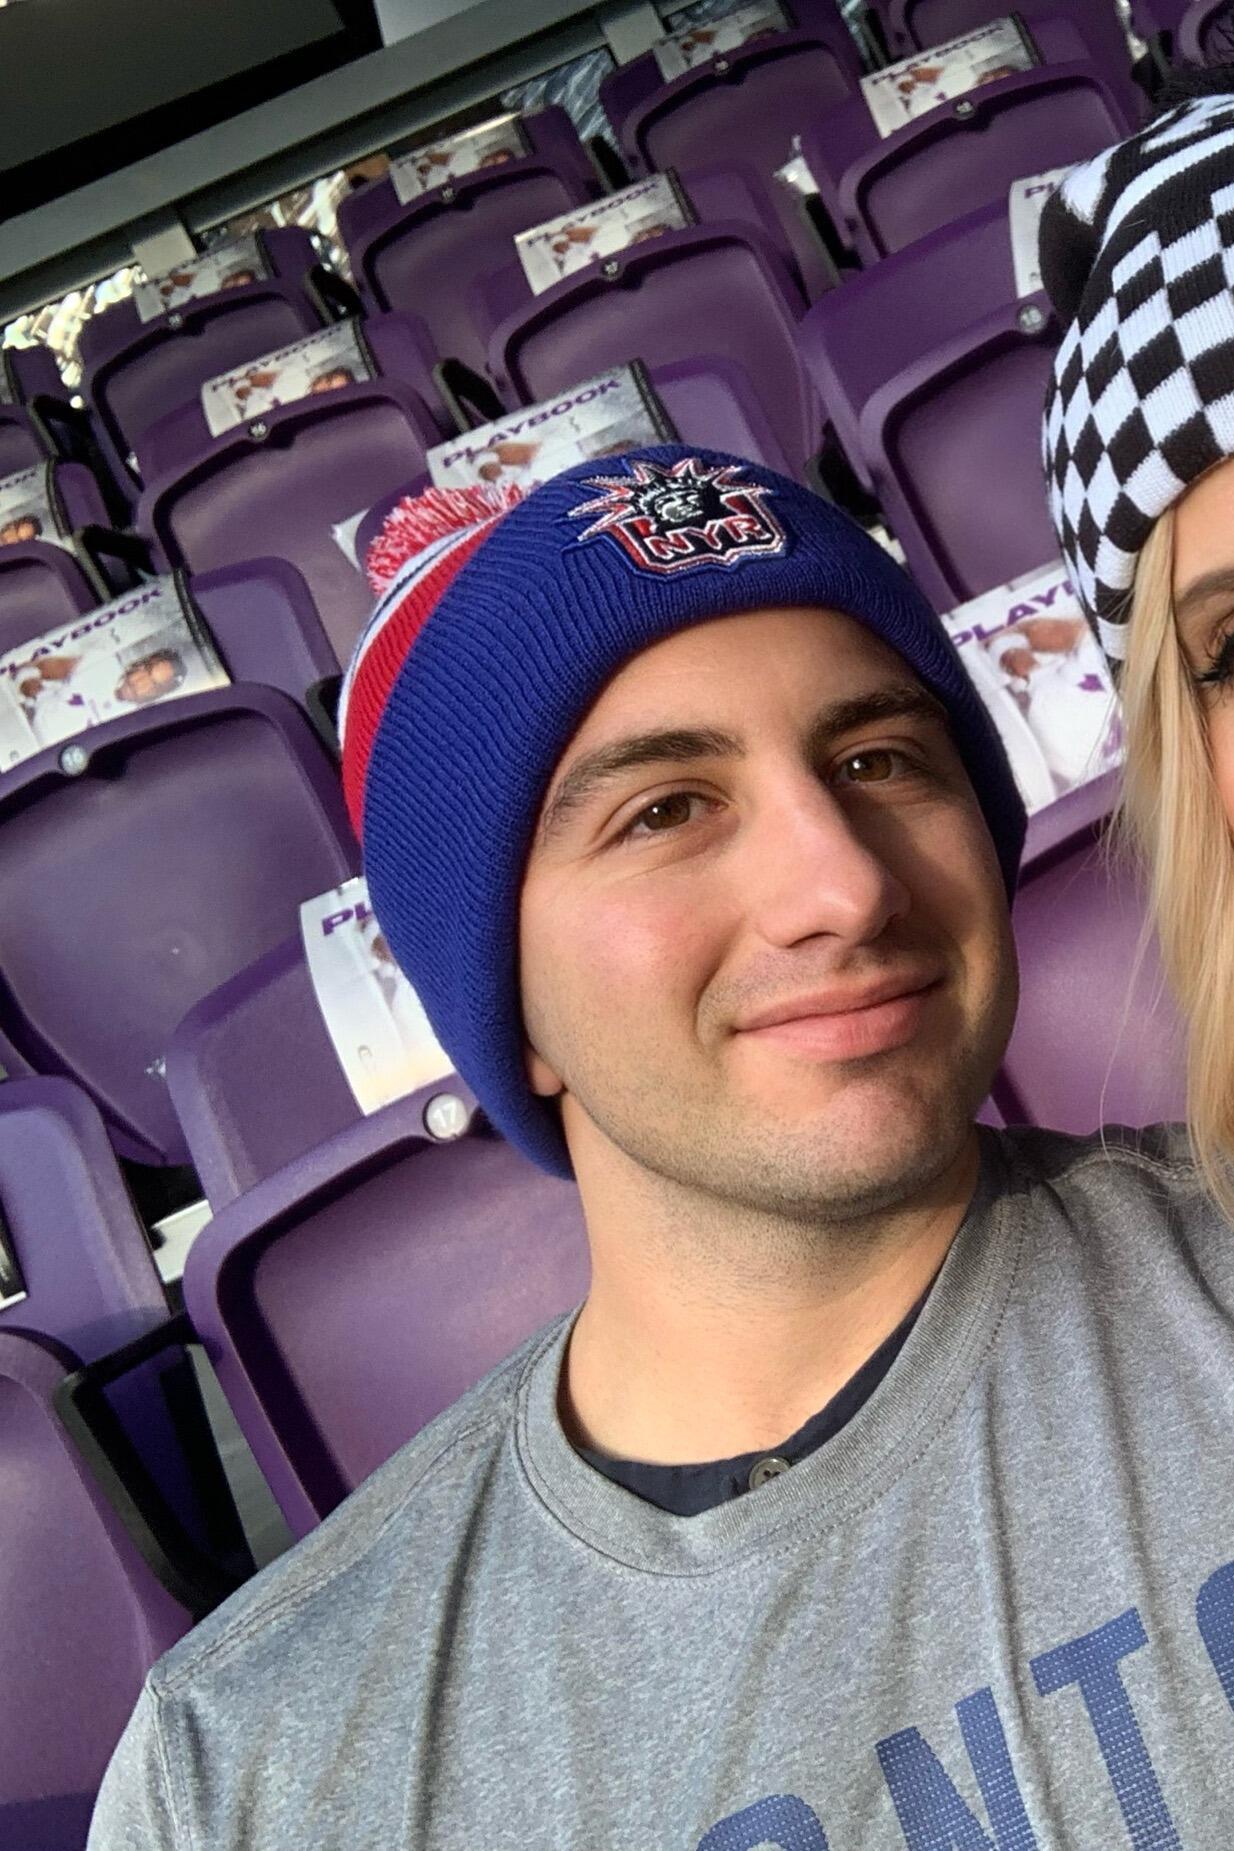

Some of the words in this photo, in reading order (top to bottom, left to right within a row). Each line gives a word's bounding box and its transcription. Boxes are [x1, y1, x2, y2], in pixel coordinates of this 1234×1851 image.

[442, 379, 621, 468] PLAYBOOK
[643, 513, 772, 560] NYR
[433, 1102, 457, 1128] 17
